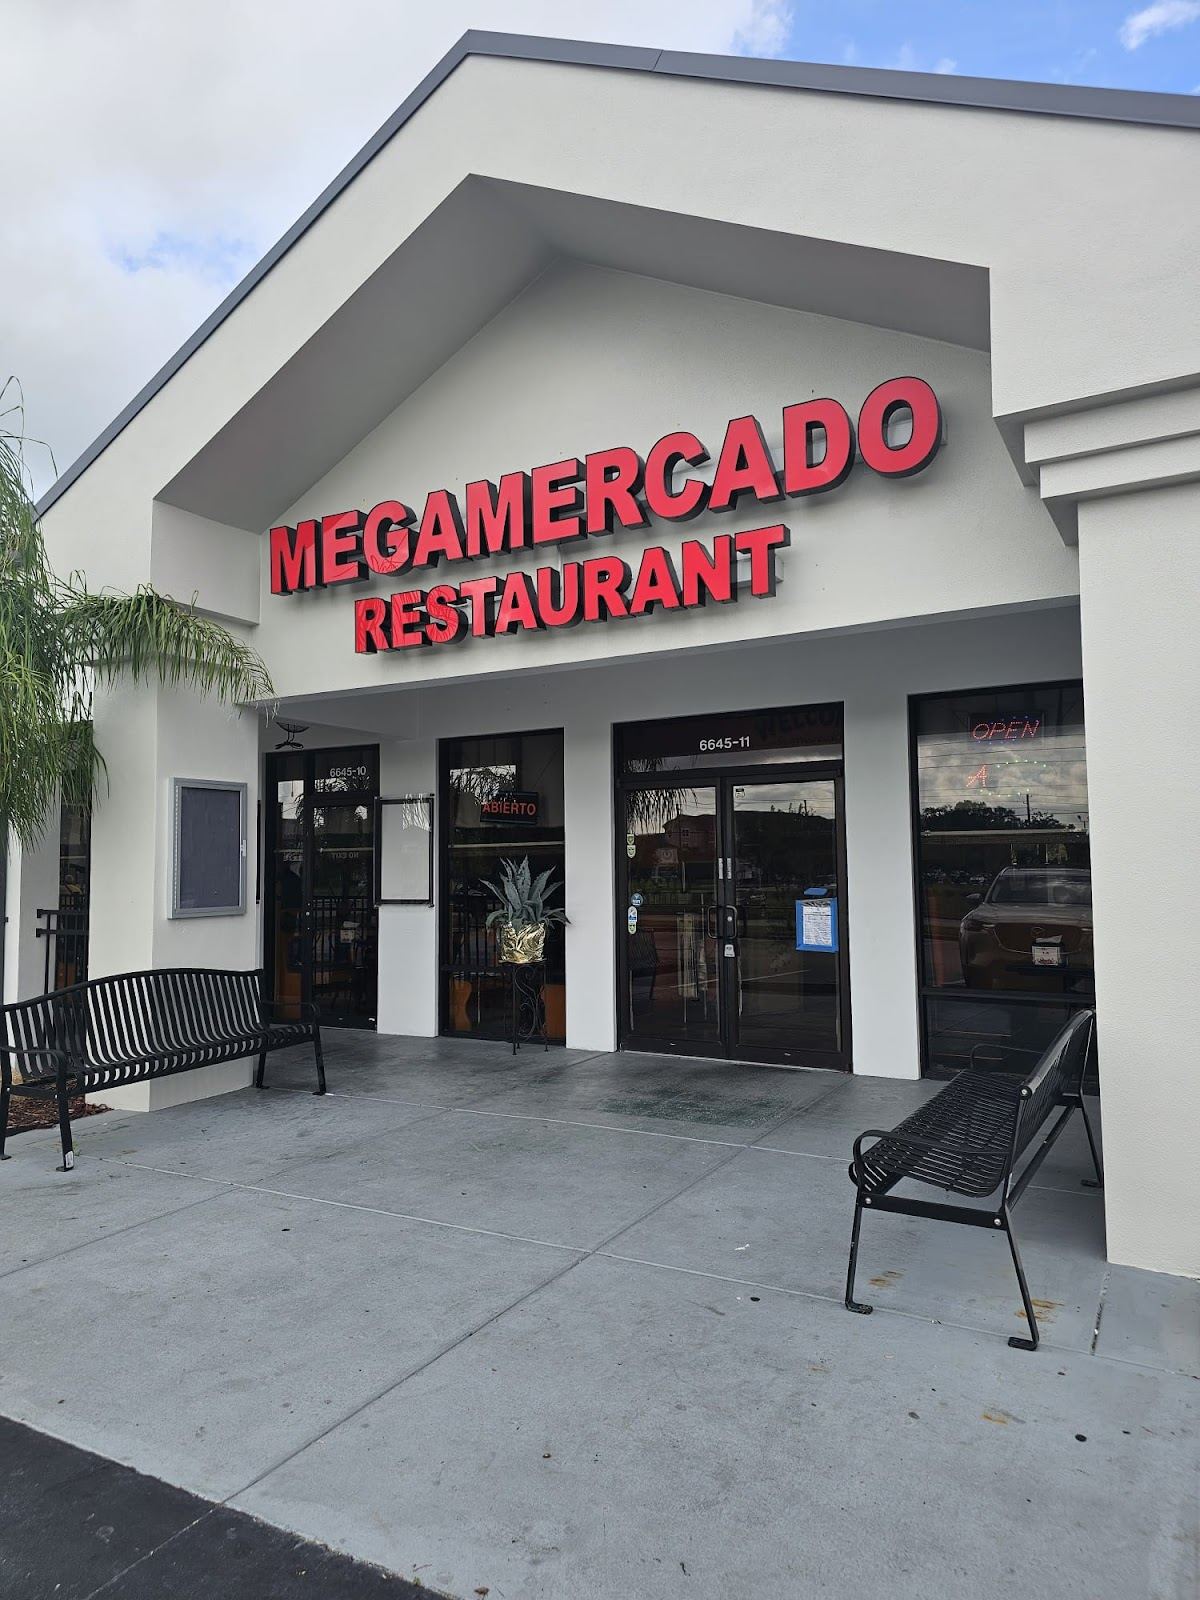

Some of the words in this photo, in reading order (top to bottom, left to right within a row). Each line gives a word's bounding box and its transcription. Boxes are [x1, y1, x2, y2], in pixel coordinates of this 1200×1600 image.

[270, 376, 943, 595] MEGAMERCADO
[355, 524, 790, 654] RESTAURANT
[971, 719, 1041, 740] OPEN
[699, 736, 750, 751] 6645-11
[329, 766, 367, 779] 6645-10
[482, 801, 537, 815] ABIERTO
